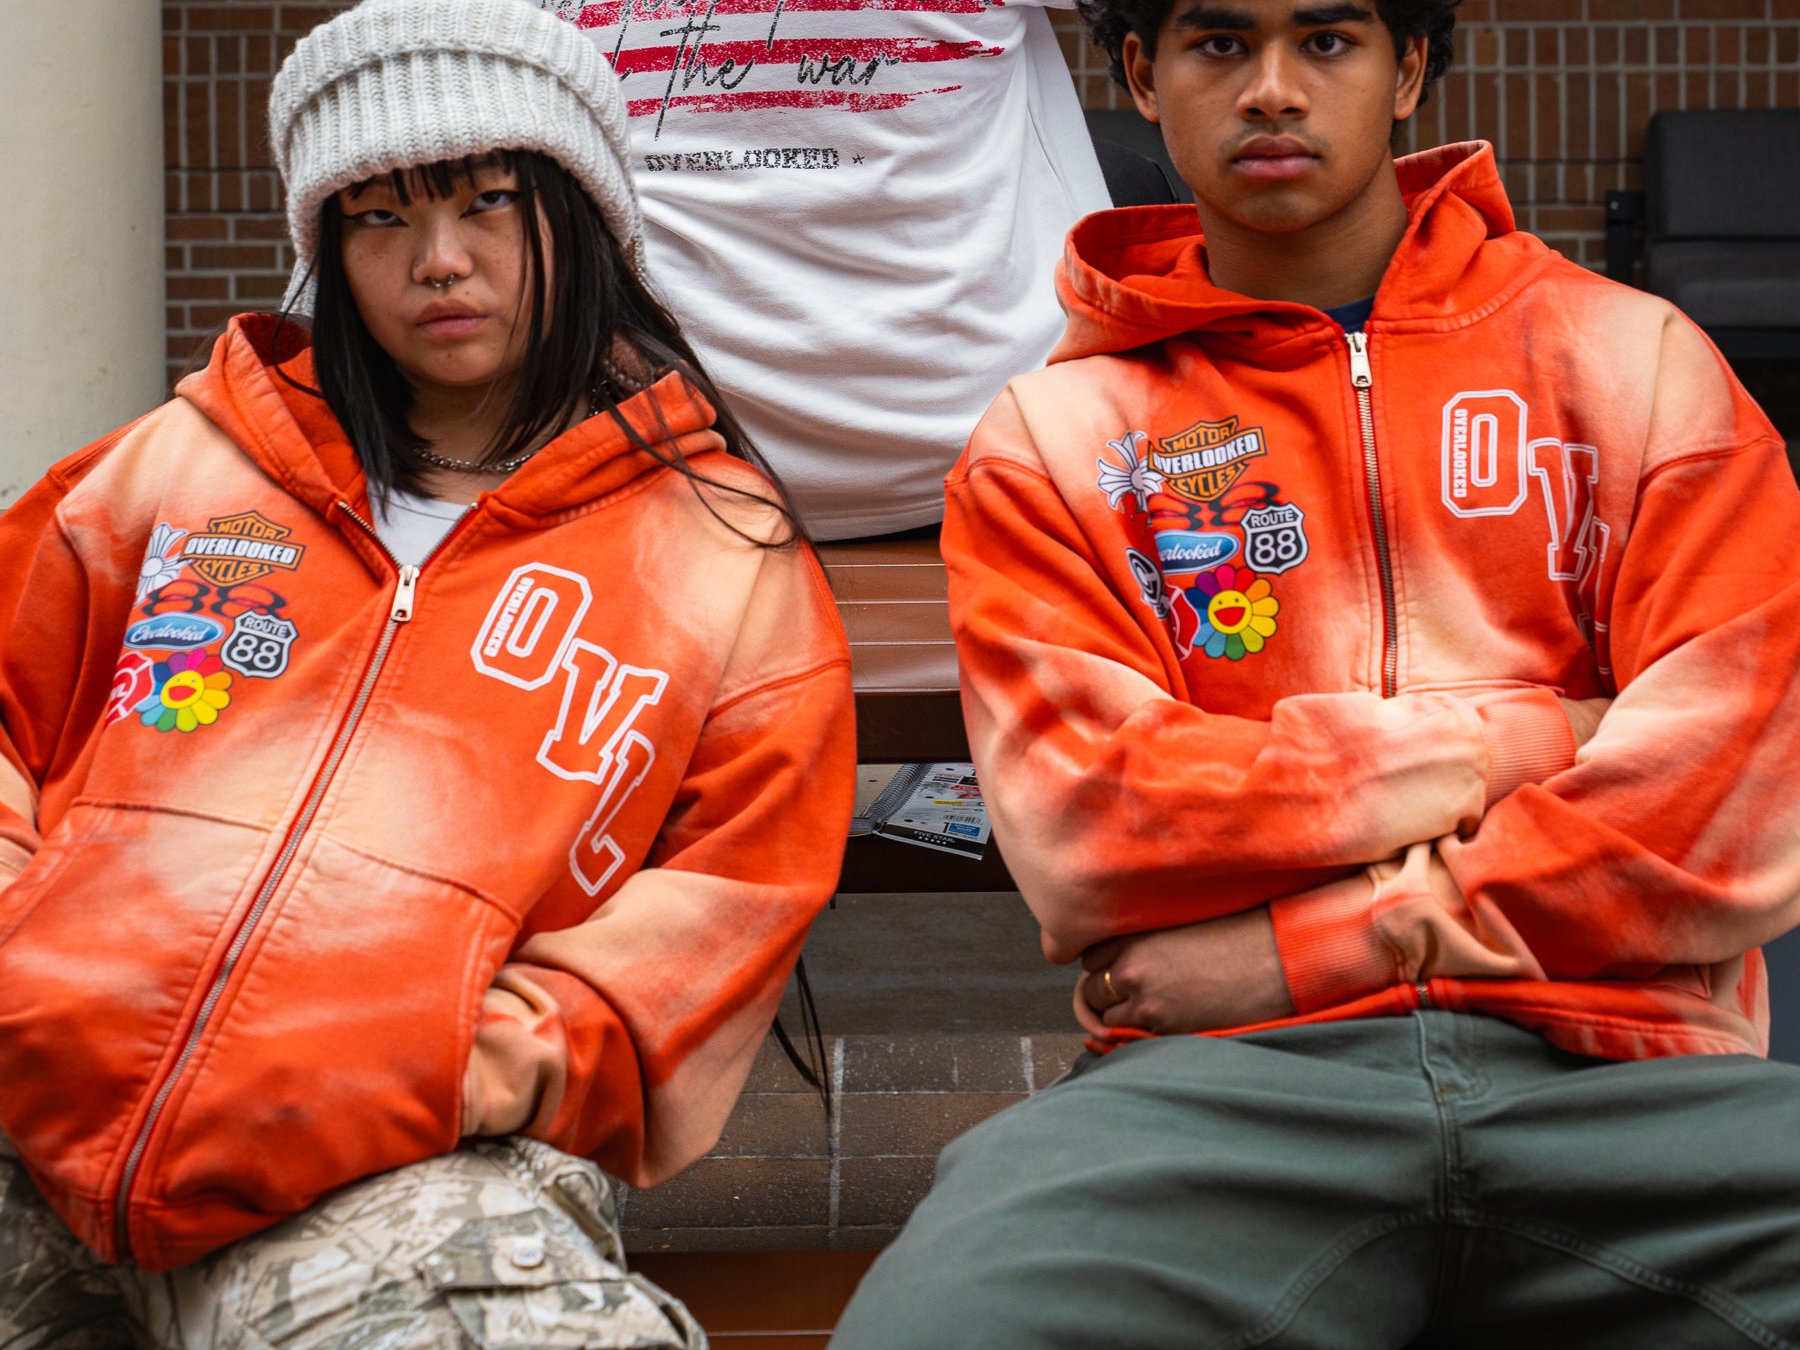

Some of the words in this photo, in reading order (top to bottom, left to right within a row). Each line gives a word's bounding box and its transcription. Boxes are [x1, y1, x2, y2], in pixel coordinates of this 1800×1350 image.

[797, 52, 900, 88] war
[644, 147, 840, 171] OVERLOOKED
[1172, 427, 1231, 451] MOTOR
[1453, 408, 1468, 498] OVERLOOKED
[1153, 433, 1259, 475] OVERLOOKED
[1176, 465, 1236, 497] CYCLES
[217, 517, 278, 540] MOTOR
[1251, 510, 1295, 528] ROUTE
[184, 537, 297, 565] OVERLOOKED
[1254, 528, 1298, 565] 88
[201, 559, 262, 582] CYCLES
[243, 615, 289, 639] ROUTE
[483, 577, 535, 658] OVERLOOKED
[230, 634, 281, 670] 88
[913, 830, 932, 839] FIVE
[933, 833, 954, 843] STAR
